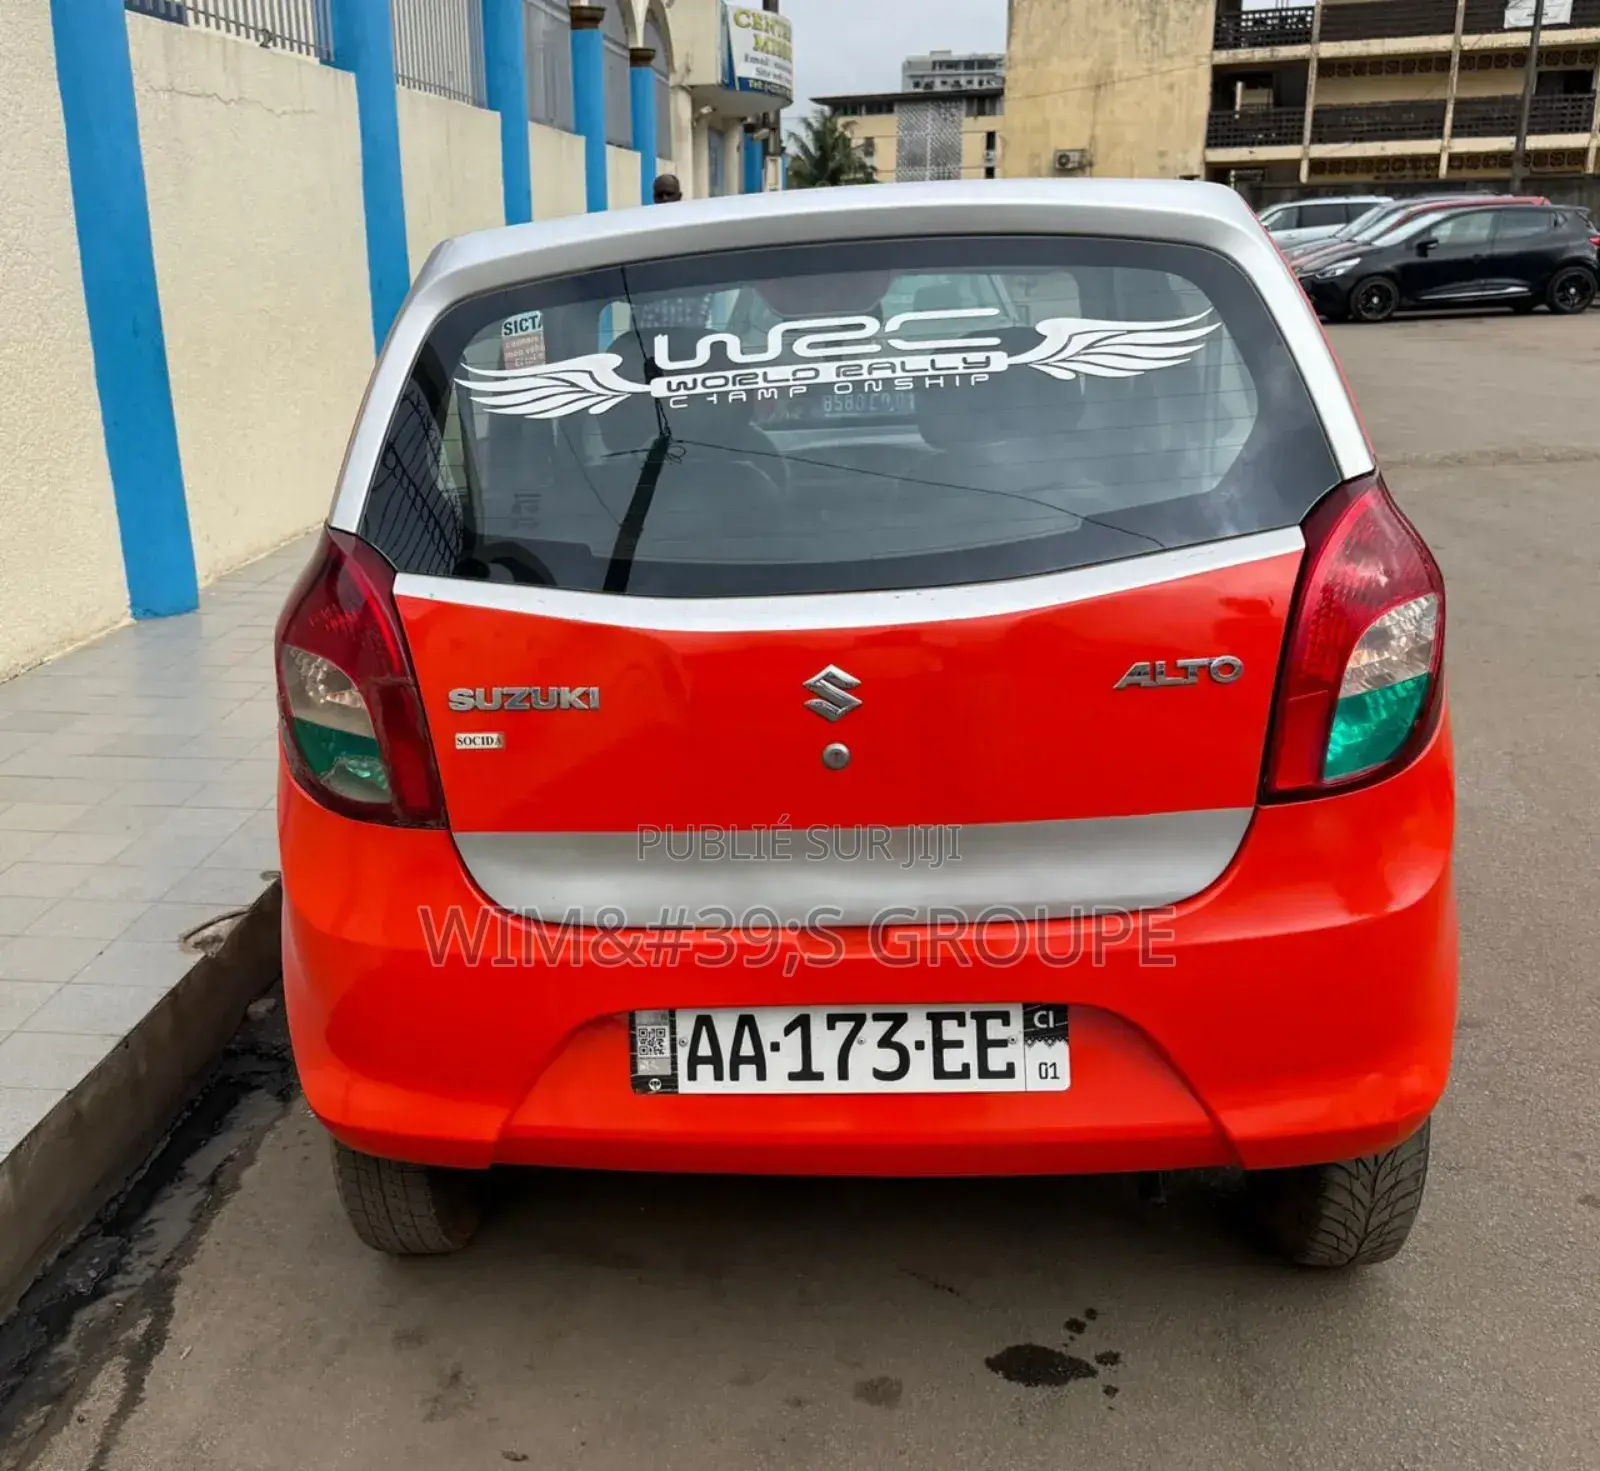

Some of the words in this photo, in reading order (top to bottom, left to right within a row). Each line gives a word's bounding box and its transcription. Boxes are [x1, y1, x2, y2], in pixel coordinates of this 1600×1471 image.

[654, 307, 1001, 371] WRC
[666, 367, 820, 393] WORLD
[835, 355, 991, 378] RALLY
[1112, 655, 1244, 690] ALTO
[448, 686, 600, 711] SUZUKI
[456, 735, 503, 747] SOCIDA
[1033, 1010, 1056, 1029] CI
[1037, 1062, 1060, 1080] 01
